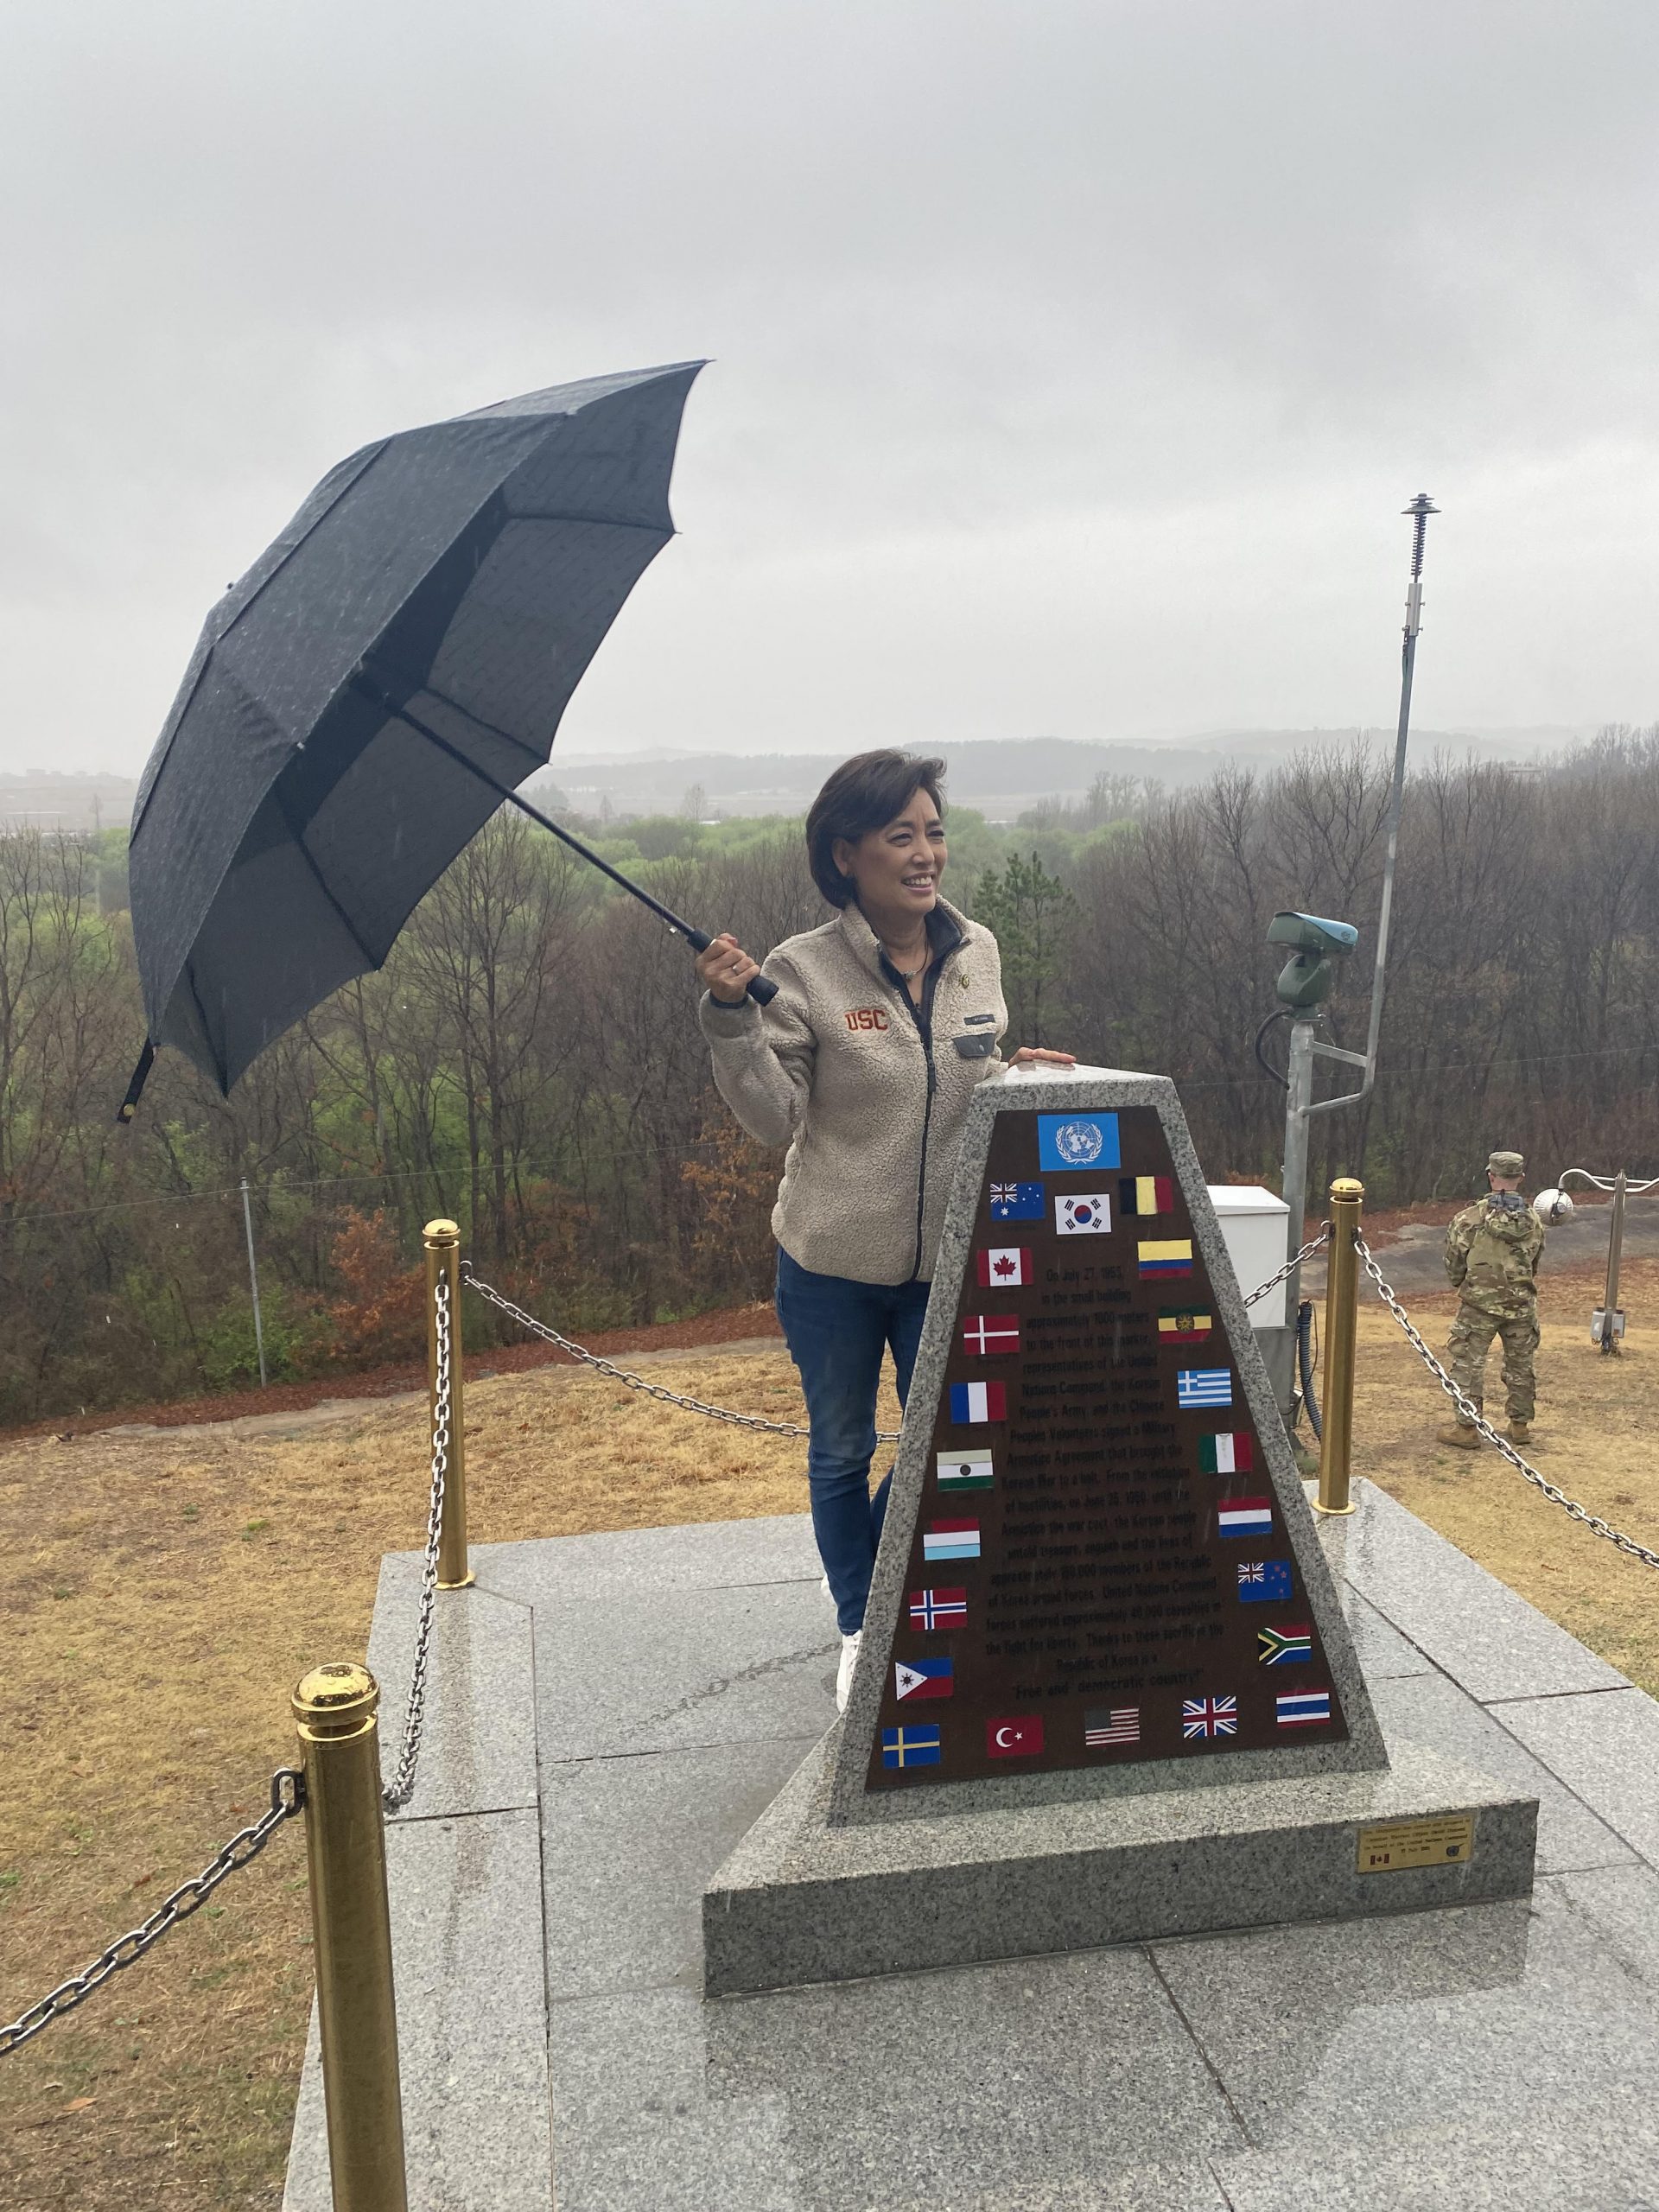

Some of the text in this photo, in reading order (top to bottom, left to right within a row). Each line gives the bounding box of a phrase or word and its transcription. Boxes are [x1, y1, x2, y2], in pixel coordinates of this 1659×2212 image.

[844, 1009, 888, 1031] USC
[1053, 1292, 1067, 1305] the
[1071, 1289, 1093, 1303] small
[1096, 1288, 1131, 1304] building
[1027, 1314, 1090, 1332] approximately
[1027, 1338, 1036, 1351] to
[1040, 1337, 1054, 1350] the
[1057, 1336, 1080, 1350] front
[1084, 1334, 1094, 1348] of
[1023, 1358, 1094, 1375] representatives
[1097, 1357, 1106, 1370] of
[1022, 1383, 1056, 1396] Nations
[1128, 1378, 1160, 1391] Korean
[1108, 1447, 1126, 1460] that
[1059, 1474, 1069, 1486] to
[1106, 1470, 1129, 1481] From
[1133, 1469, 1147, 1481] the
[1005, 1498, 1014, 1513] of
[1099, 1654, 1109, 1669] of
[1112, 1652, 1138, 1668] Korea
[1047, 1682, 1069, 1697] and
[1078, 1675, 1144, 1693] democratic
